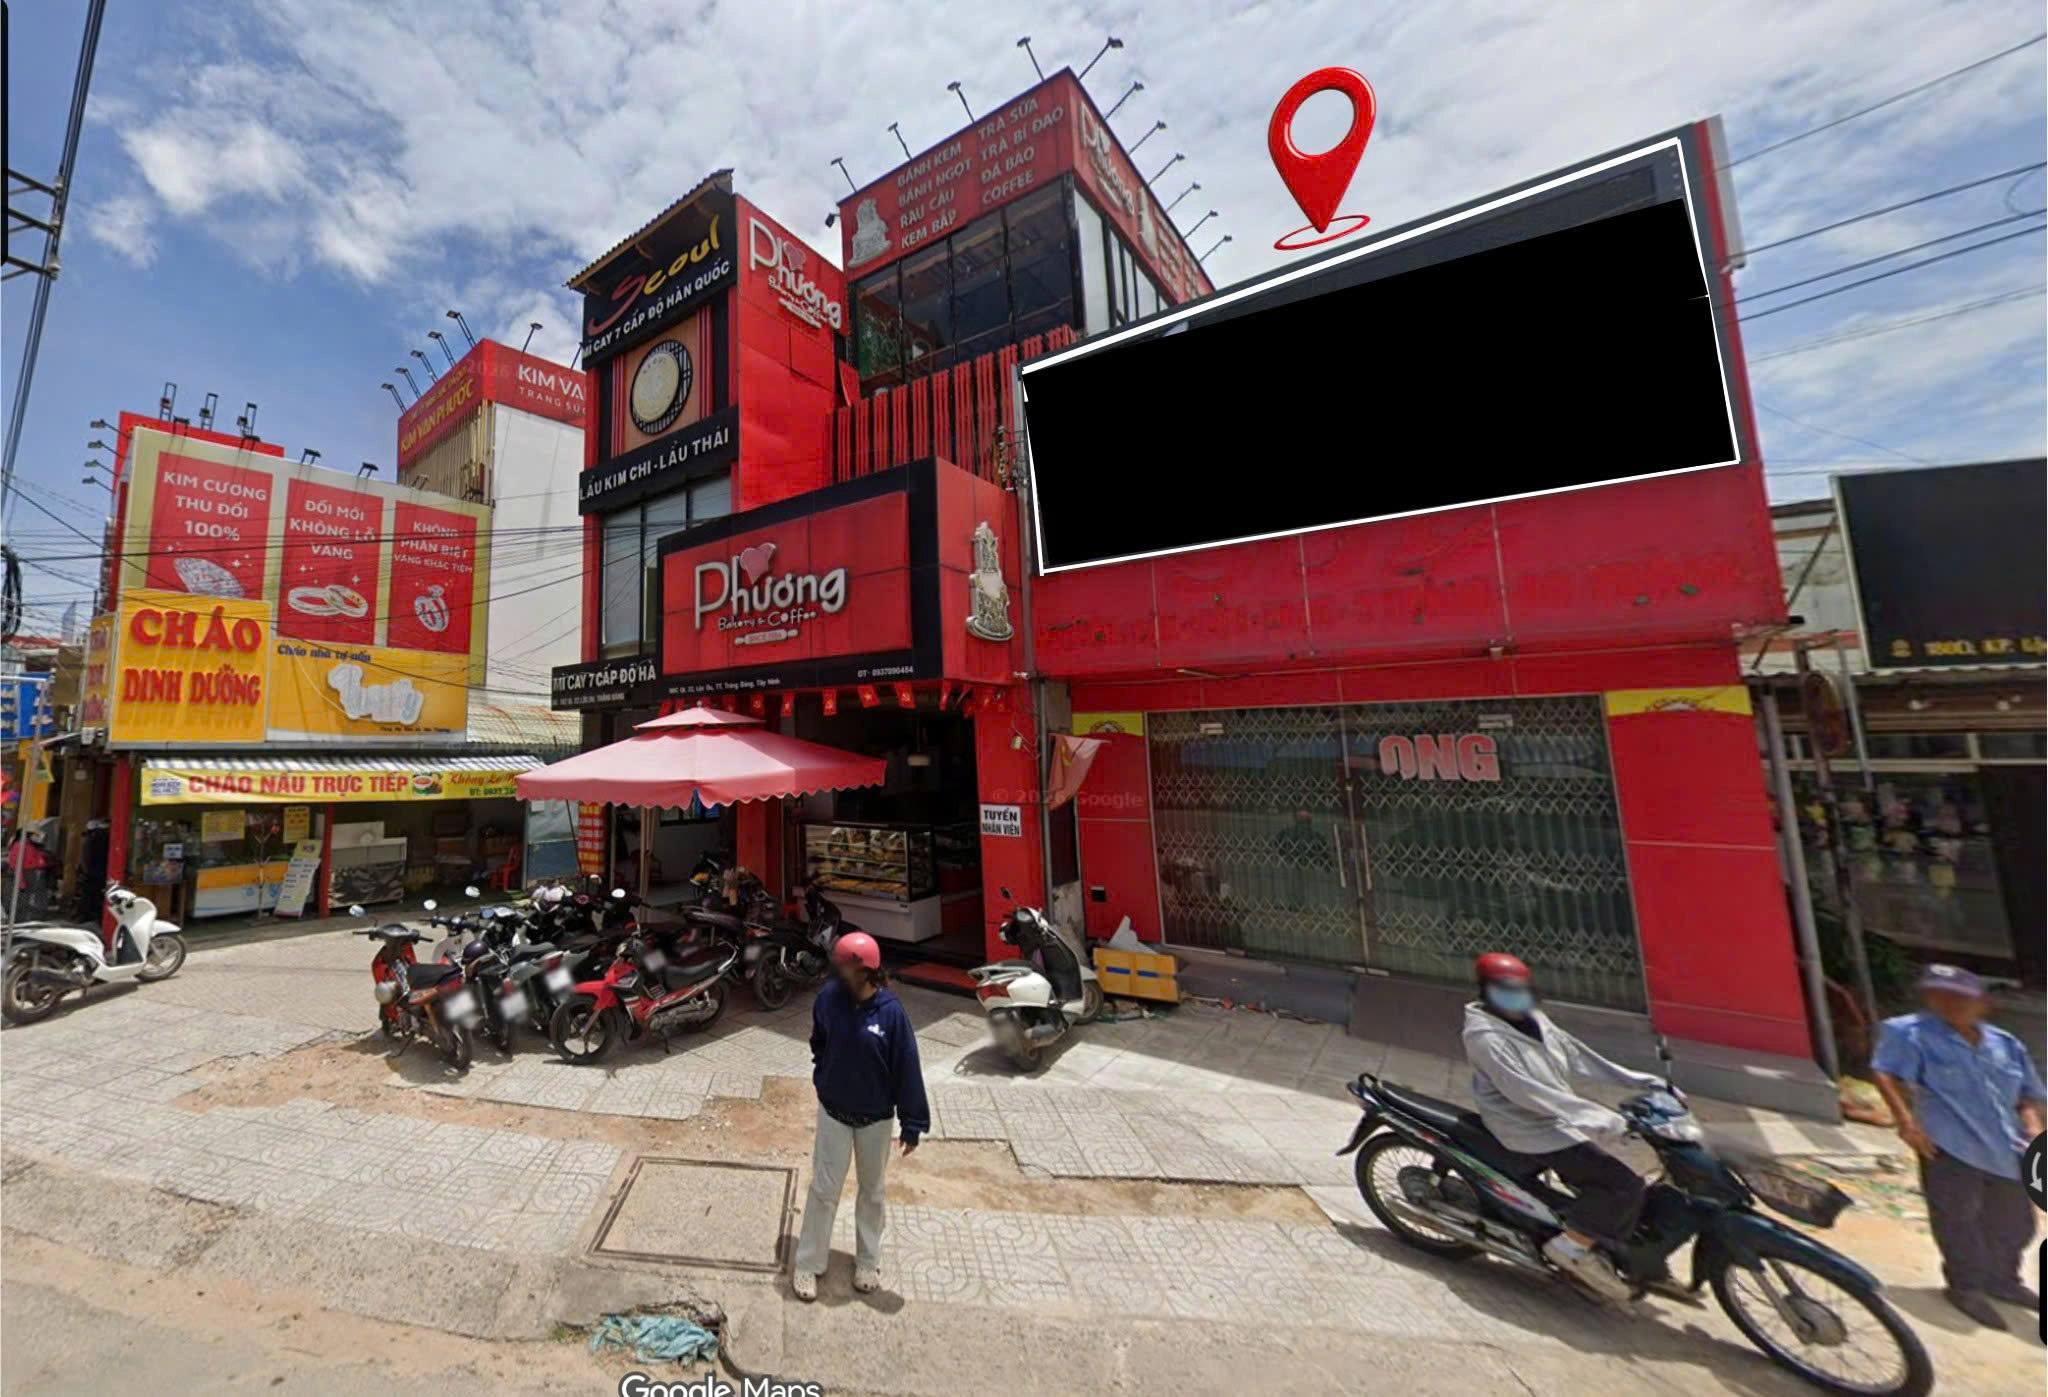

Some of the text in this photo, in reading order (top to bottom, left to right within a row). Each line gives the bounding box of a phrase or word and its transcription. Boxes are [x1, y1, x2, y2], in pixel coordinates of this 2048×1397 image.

[1032, 107, 1063, 134] ĐAO
[898, 141, 961, 188] BÁNH KEM
[898, 158, 972, 208] BÁNH NGỌT
[982, 170, 1034, 204] COFFEE
[901, 206, 924, 228] RAU
[901, 229, 927, 249] KEM
[587, 214, 721, 336] Seoul
[749, 217, 842, 329] Phương
[593, 331, 613, 353] CAY
[614, 327, 622, 340] 7
[623, 308, 646, 335] CẤP
[647, 299, 664, 320] ĐỘ
[666, 283, 692, 307] HÀN
[694, 257, 730, 292] QUỐC
[518, 364, 555, 391] KIM
[519, 387, 561, 407] TRANG
[604, 470, 627, 491] KIM
[629, 460, 651, 481] CHI
[659, 439, 688, 470] LẨU
[692, 425, 729, 456] THÁI
[163, 472, 266, 501] KIM CƯƠNG
[176, 495, 212, 512] THU
[184, 520, 240, 541] 100%
[290, 518, 350, 539] KHÔNG
[695, 555, 845, 630] Phương
[130, 605, 262, 653] CHÁO
[767, 608, 816, 626] Coffee
[122, 668, 184, 705] DINH
[188, 663, 261, 708] DƯỠNG
[567, 674, 587, 690] CAY
[589, 673, 596, 688] 7
[595, 663, 617, 688] CẤP
[620, 663, 637, 688] ĐỘ
[188, 772, 253, 793] CHÁO
[260, 772, 305, 793] NẤU
[312, 774, 363, 796] TRỰC
[370, 771, 408, 792] TIẾP
[984, 807, 1017, 822] TUYỂN
[982, 821, 1020, 836] NHÂN VIÊN
